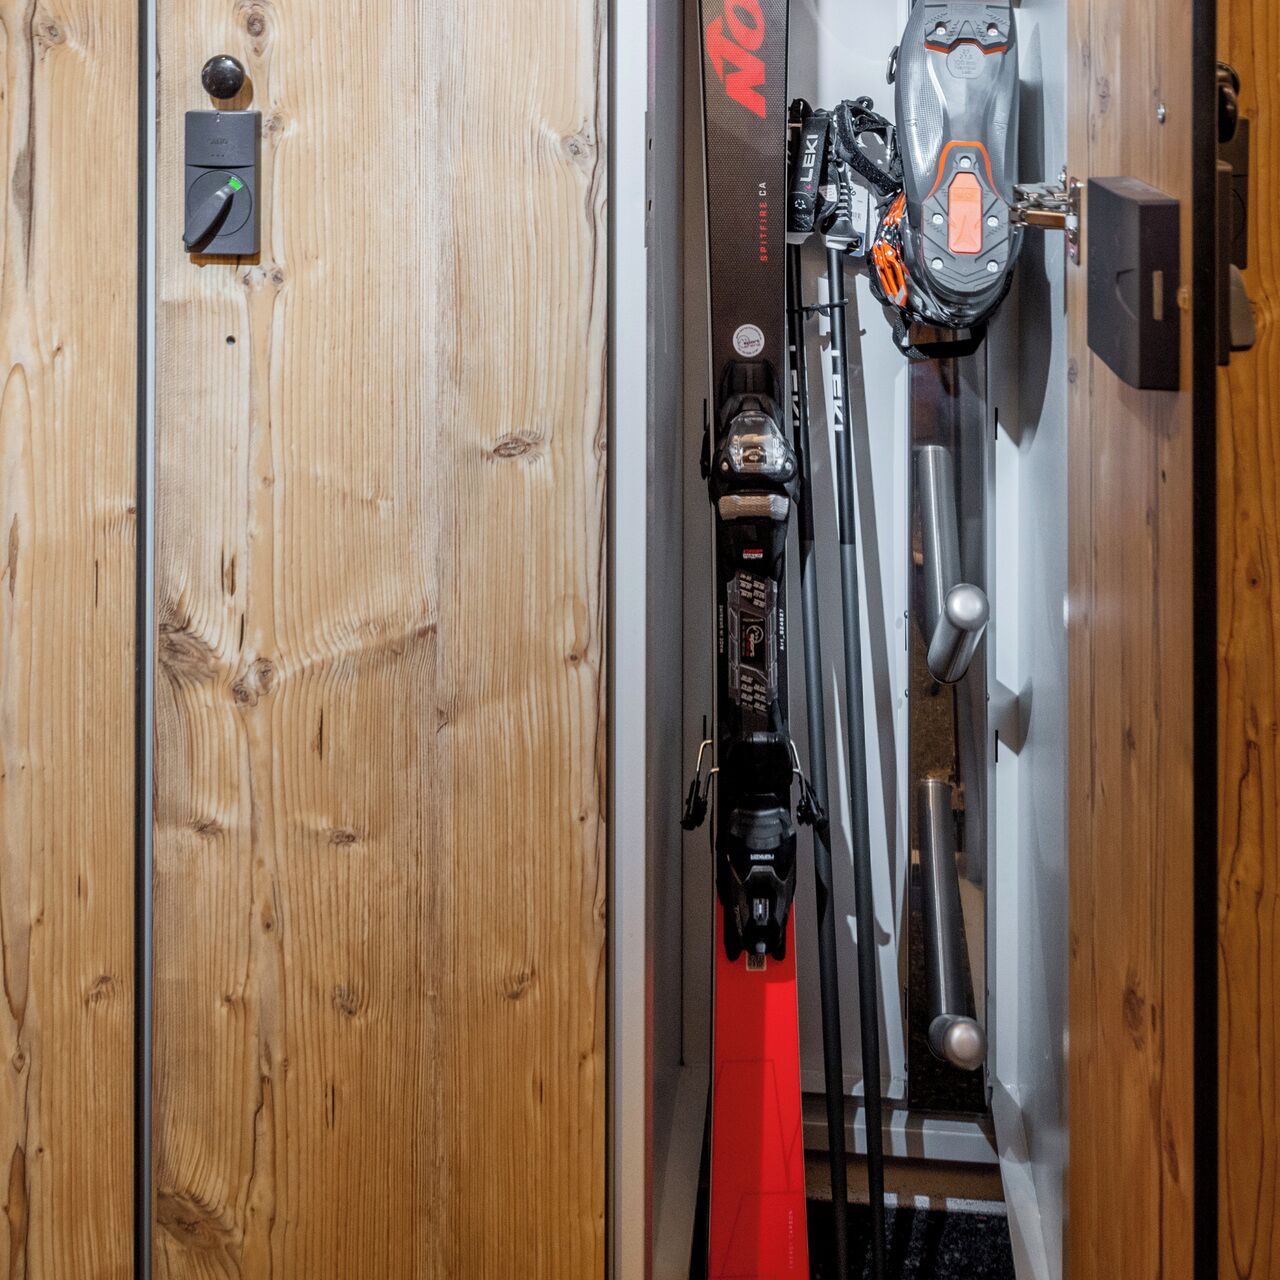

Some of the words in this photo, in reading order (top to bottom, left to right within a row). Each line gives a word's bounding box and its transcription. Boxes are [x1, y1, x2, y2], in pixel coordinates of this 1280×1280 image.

[800, 134, 819, 182] LEKI
[758, 182, 767, 196] CA
[759, 201, 768, 262] SPITFIRE
